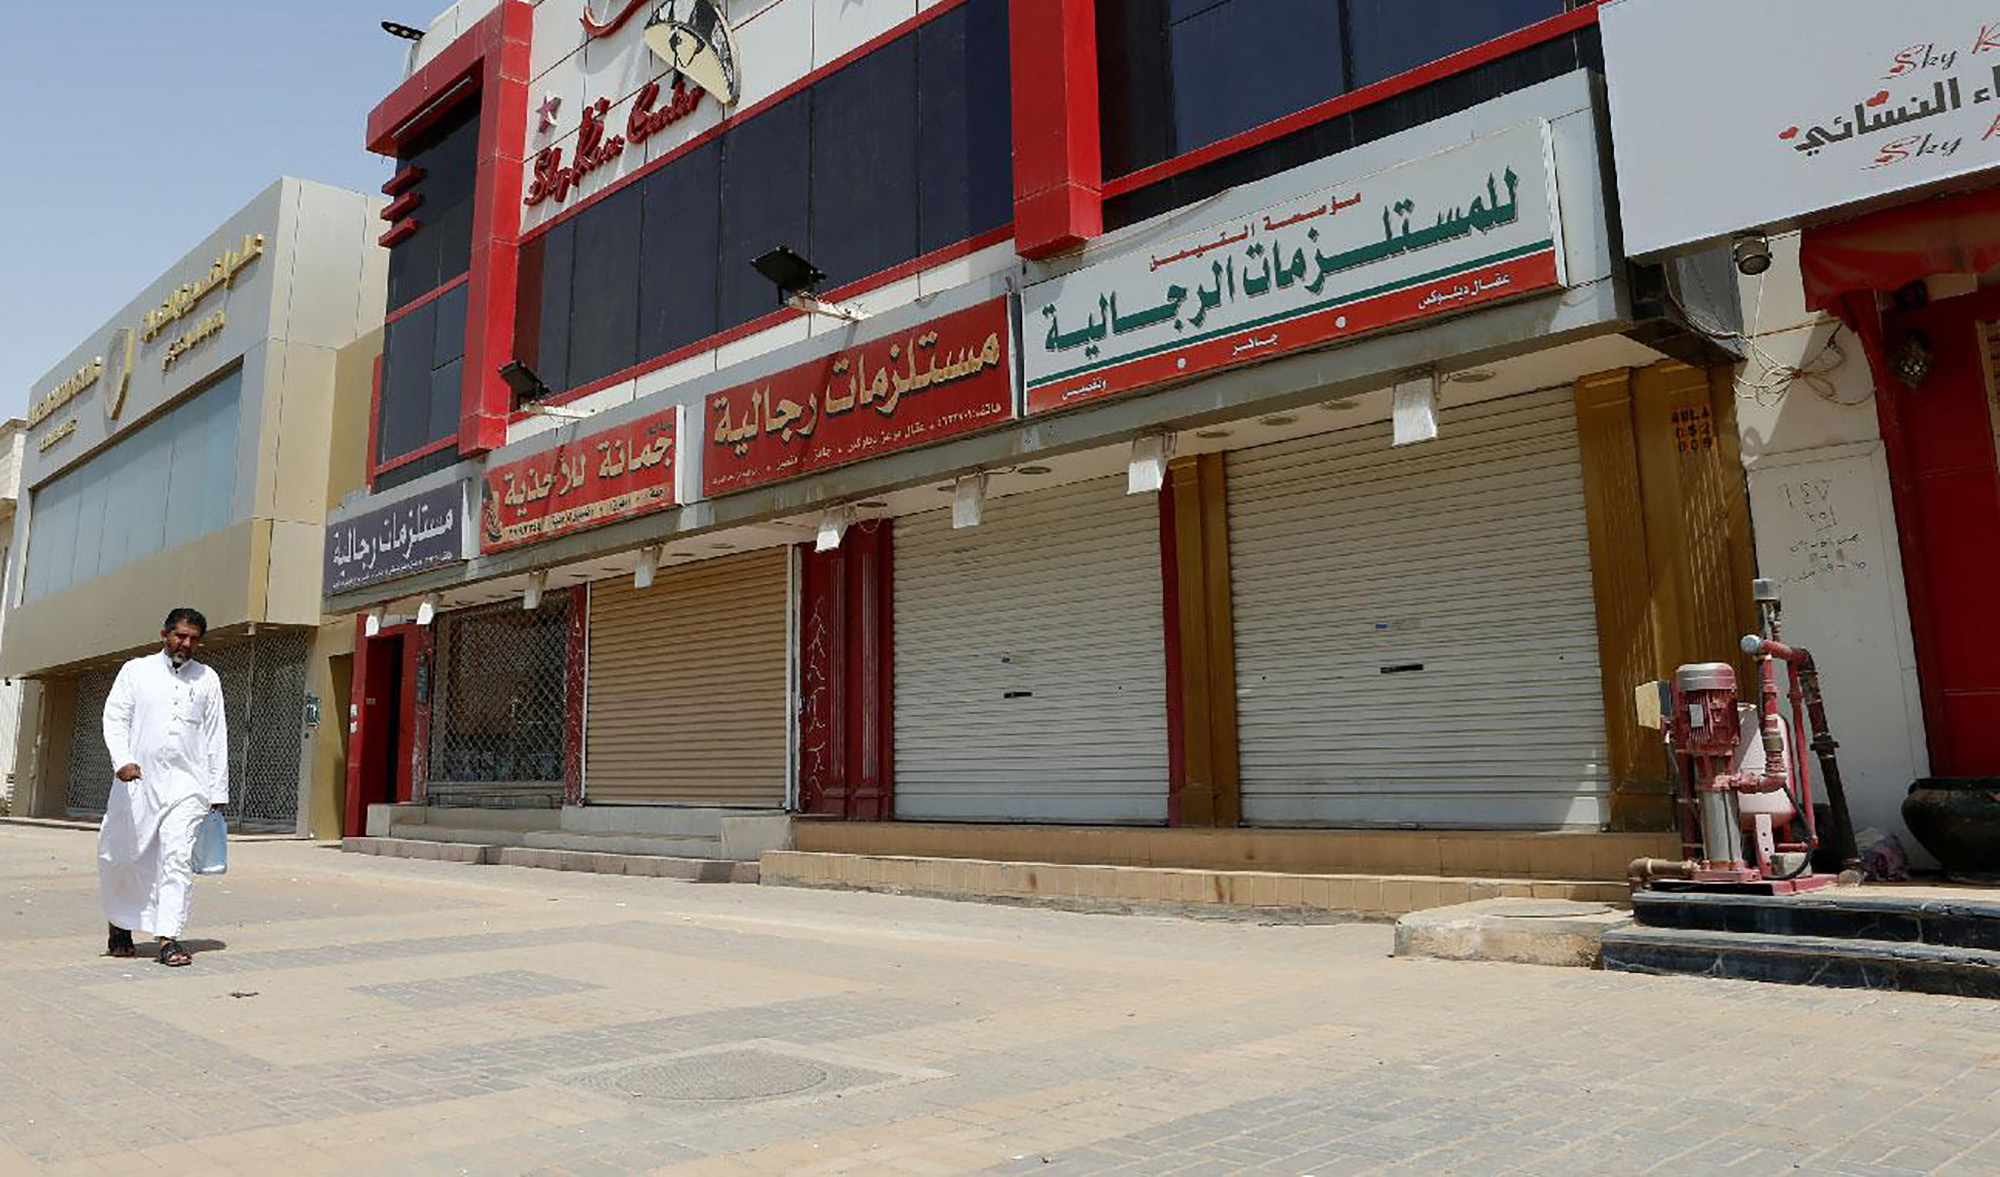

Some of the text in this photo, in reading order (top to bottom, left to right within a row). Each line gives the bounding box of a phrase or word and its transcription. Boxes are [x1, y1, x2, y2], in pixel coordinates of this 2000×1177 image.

[1880, 43, 1958, 80] Sky
[1794, 77, 1962, 157] النسائي
[1860, 133, 1963, 170] Sky
[1264, 192, 1362, 230] مؤسسة
[1042, 165, 1519, 359] للمستلزمات الرجالية
[1471, 272, 1511, 296] عقال
[712, 329, 1002, 455] مستلزمات رجالية
[332, 526, 377, 578] رجالية
[379, 503, 454, 560] مستلزمات
